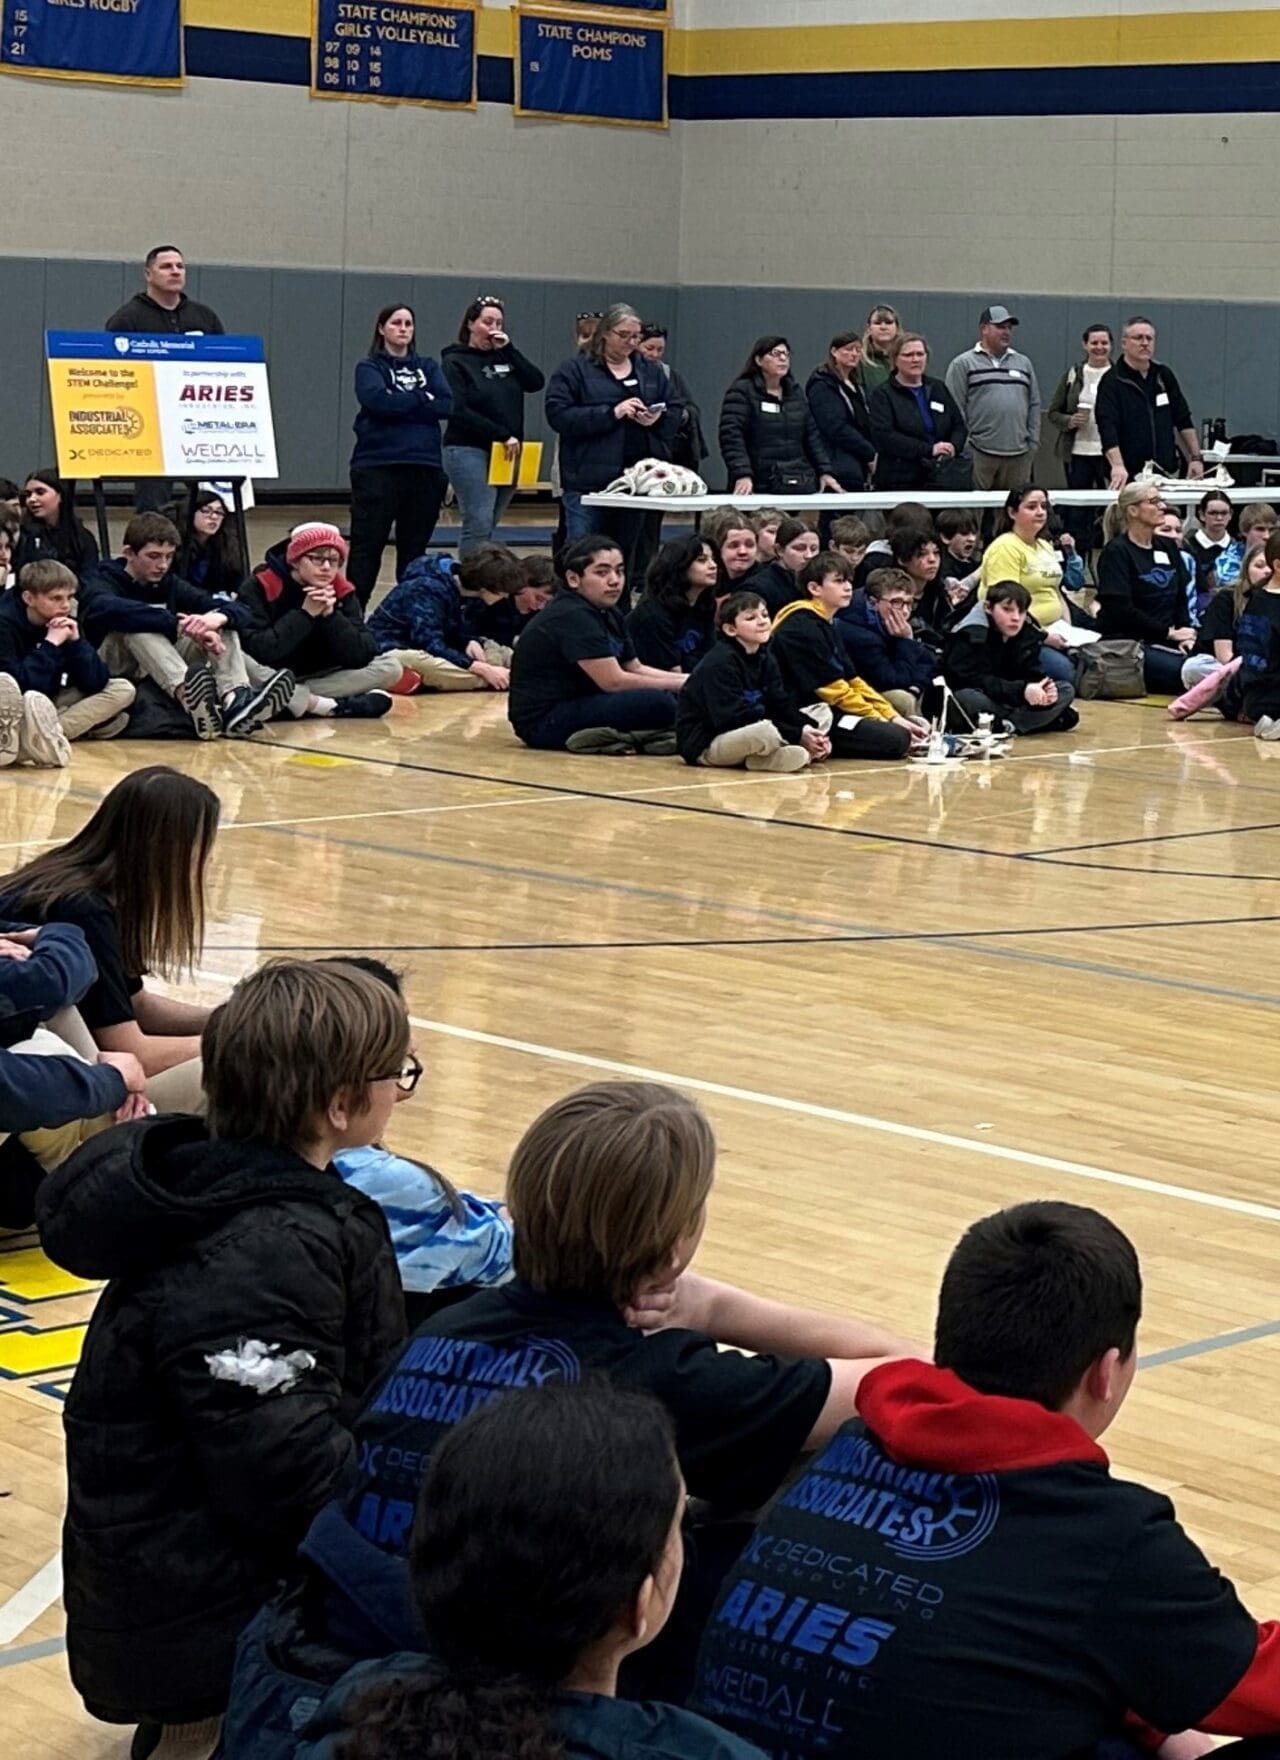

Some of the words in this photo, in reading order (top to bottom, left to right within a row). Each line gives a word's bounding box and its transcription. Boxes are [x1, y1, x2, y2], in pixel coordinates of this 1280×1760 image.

[14, 10, 28, 22] 15
[338, 4, 377, 21] STATE
[380, 8, 457, 30] CHAMPIONS
[14, 26, 27, 37] 17
[334, 22, 372, 38] GIRLS
[375, 26, 460, 48] VOLLEYBALL
[538, 23, 573, 41] STATE
[576, 28, 648, 48] CHAMPIONS
[11, 43, 25, 55] 21
[572, 44, 612, 62] POMS
[67, 379, 90, 388] STEM
[179, 384, 255, 402] ARIES
[69, 410, 128, 423] INDUSTRIAL
[88, 448, 153, 457] DEDICATED
[370, 1374, 500, 1426] ASSOCIAT
[782, 1472, 935, 1546] ASSOCIATES
[770, 1539, 945, 1605] DEDICATED
[715, 1577, 897, 1667] ARIES
